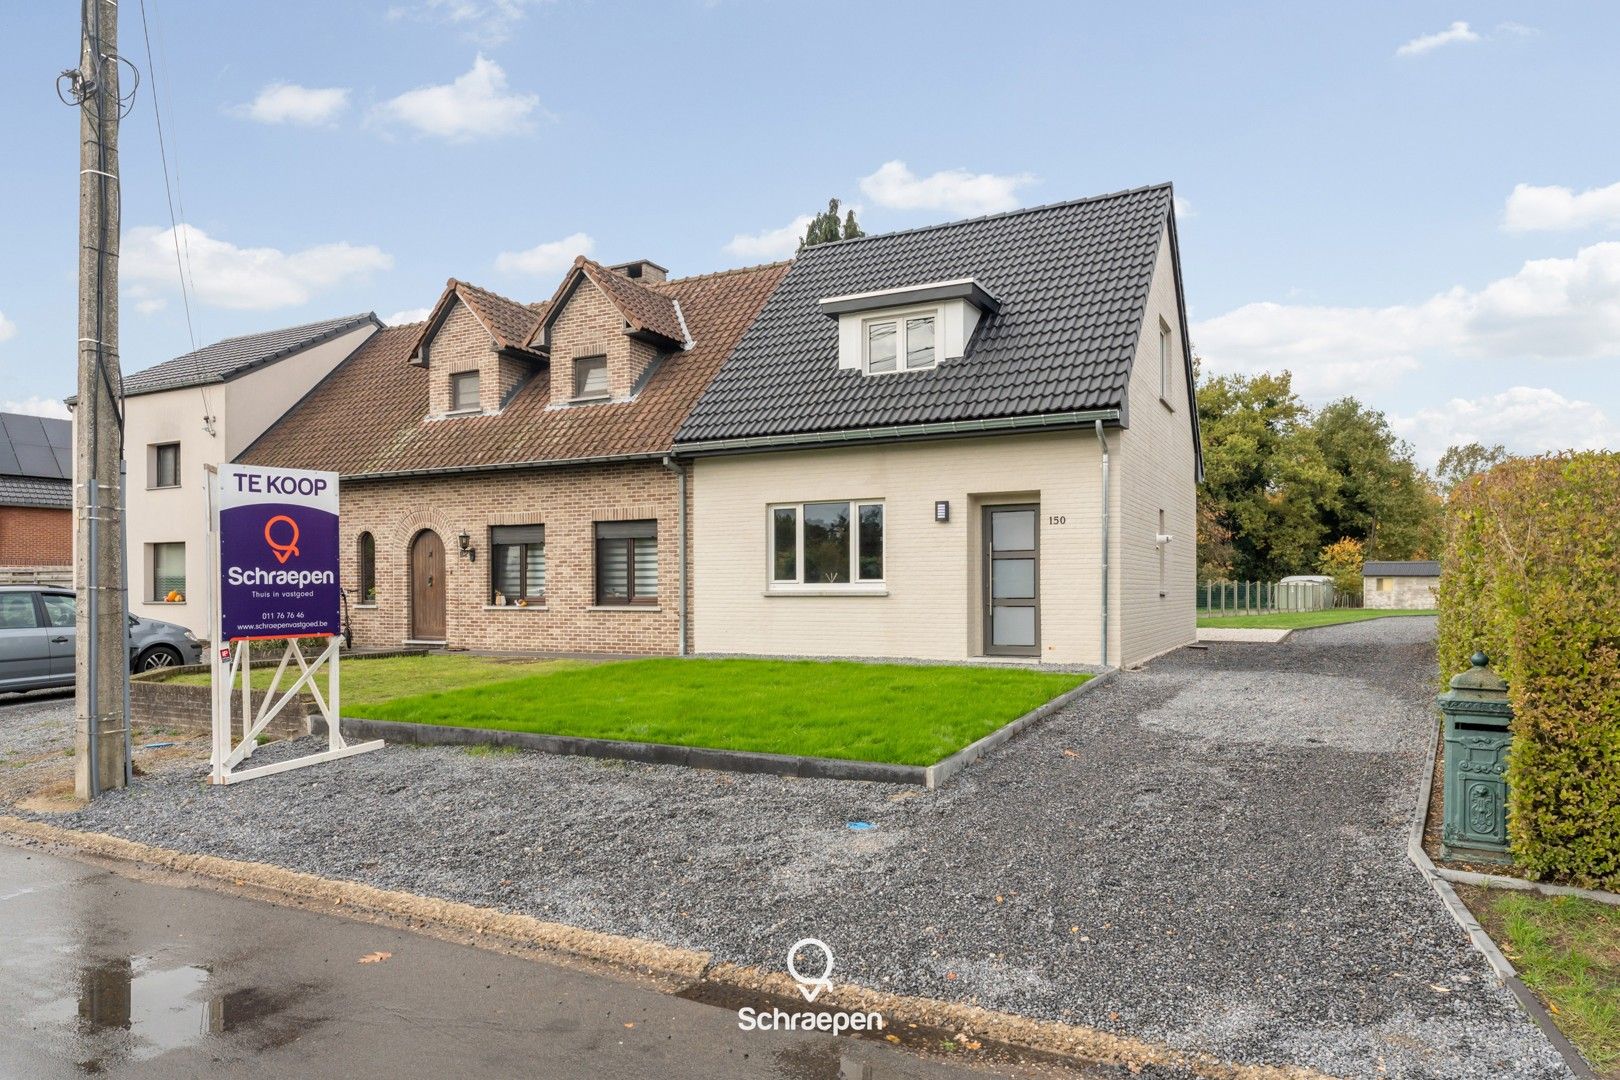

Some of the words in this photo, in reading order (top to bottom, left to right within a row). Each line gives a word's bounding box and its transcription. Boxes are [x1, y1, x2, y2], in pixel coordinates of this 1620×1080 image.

[233, 473, 262, 493] TE
[267, 475, 327, 496] KOOP
[1049, 515, 1066, 525] 150
[228, 566, 334, 589] Schraepen
[252, 590, 270, 598] Thuis
[273, 590, 280, 598] in
[282, 590, 314, 599] vastgoed
[237, 620, 328, 630] www.schraepenvastgoed.be
